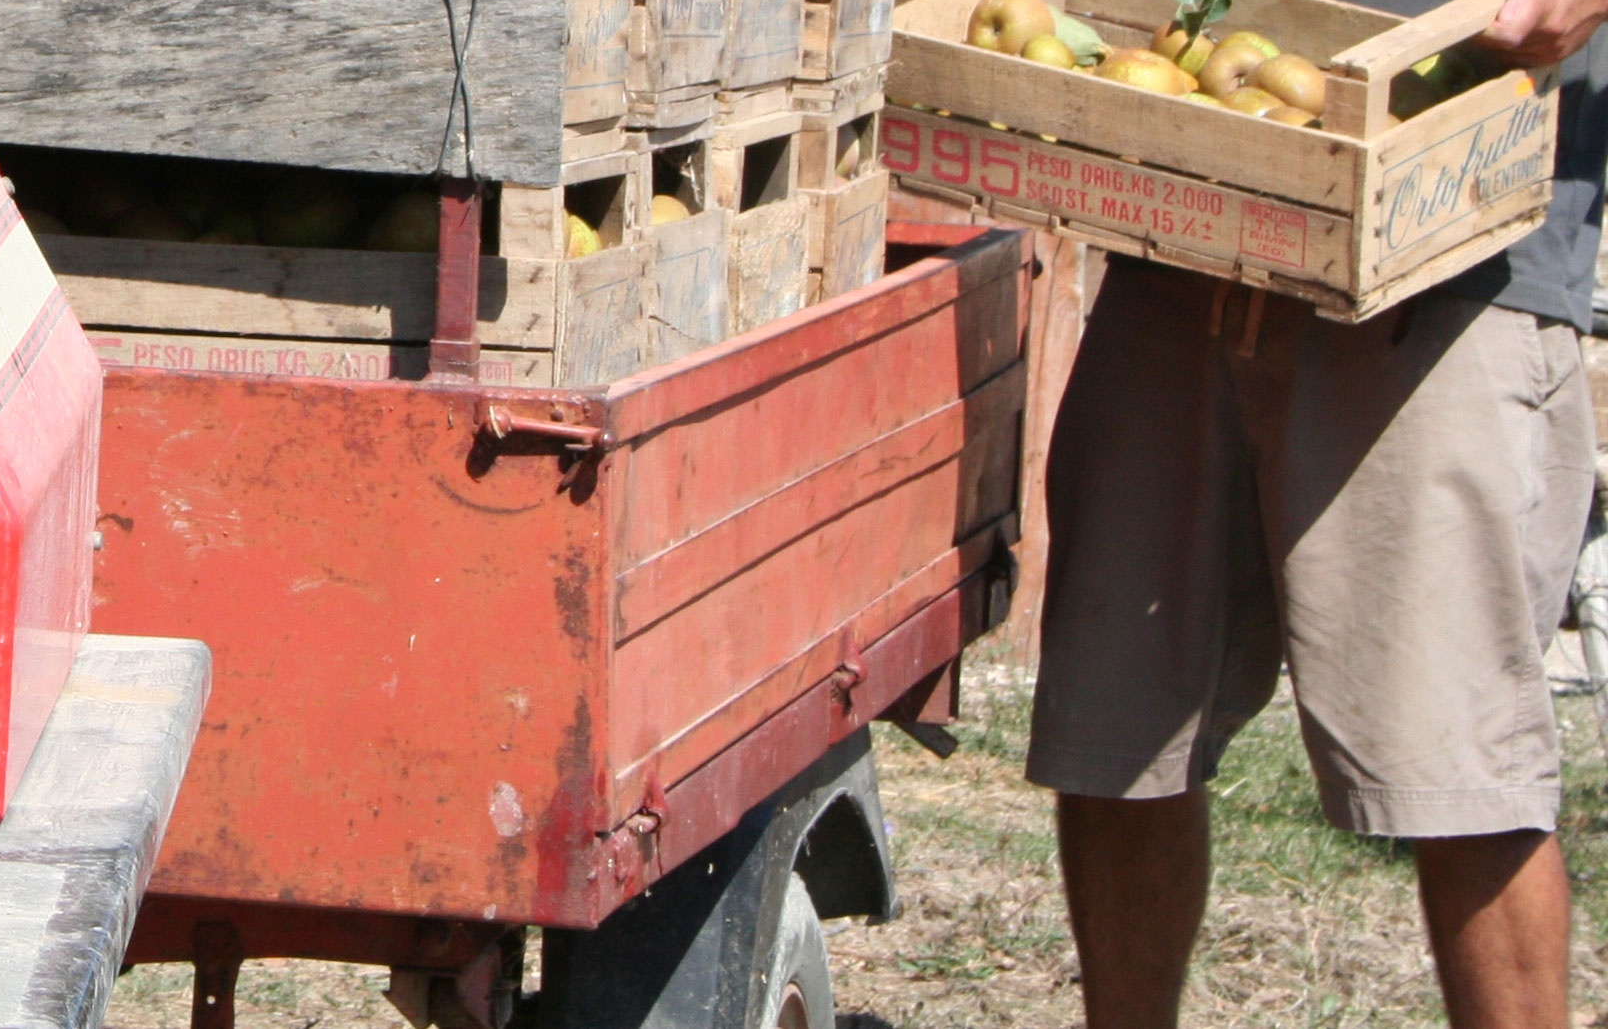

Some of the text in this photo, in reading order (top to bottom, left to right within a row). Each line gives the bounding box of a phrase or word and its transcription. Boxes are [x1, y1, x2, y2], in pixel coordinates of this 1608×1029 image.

[882, 117, 1021, 198] 995
[1027, 151, 1072, 181] PESO
[1162, 181, 1224, 217] 2.000
[1026, 179, 1092, 213] SCOST.
[1101, 196, 1143, 225] MAX
[134, 343, 193, 370] PESO
